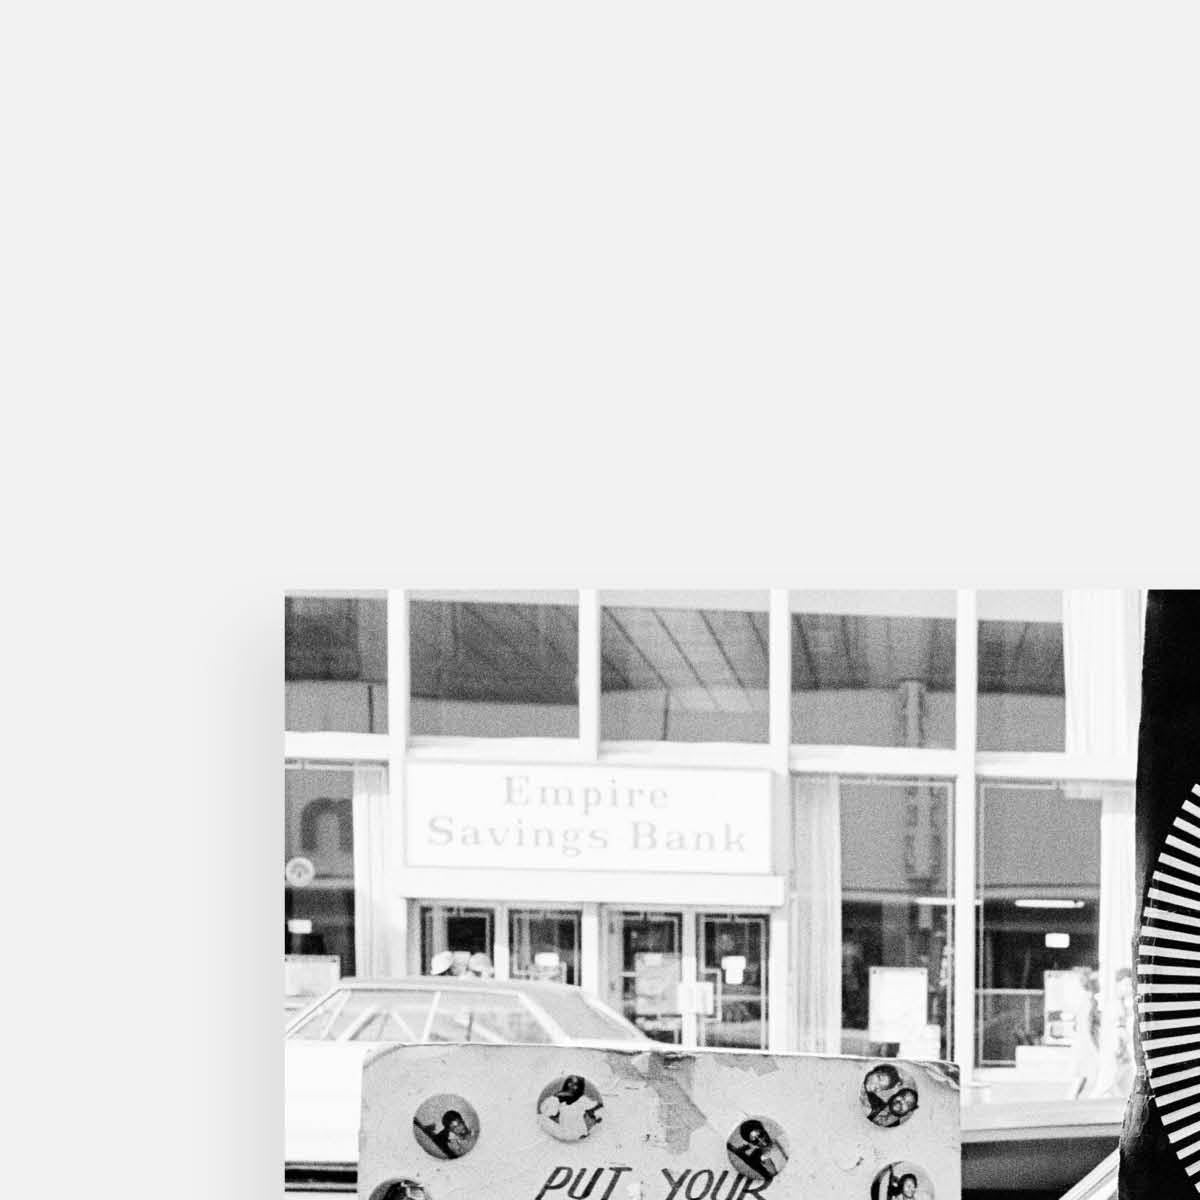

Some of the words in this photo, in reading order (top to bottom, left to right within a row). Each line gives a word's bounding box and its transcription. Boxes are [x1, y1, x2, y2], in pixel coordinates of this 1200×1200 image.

[503, 775, 670, 817] Empire
[427, 814, 609, 857] Savings
[631, 820, 746, 853] Bank
